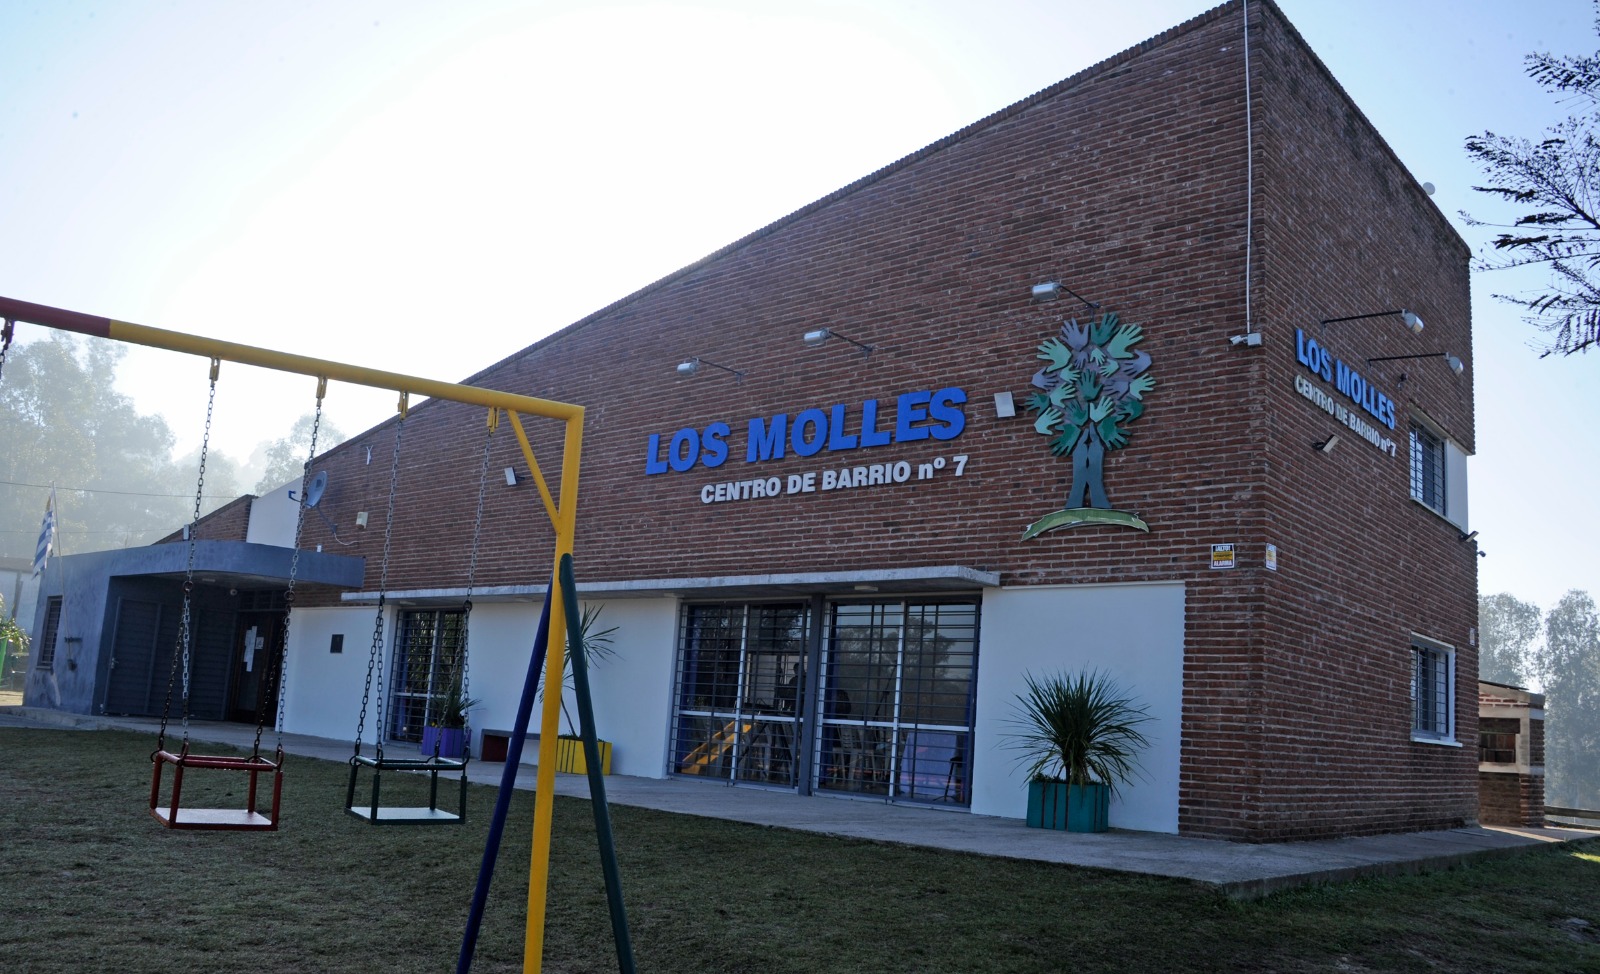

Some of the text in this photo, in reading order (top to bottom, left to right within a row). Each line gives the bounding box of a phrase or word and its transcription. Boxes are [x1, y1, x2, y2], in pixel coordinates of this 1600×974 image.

[1295, 375, 1334, 415] CENTRO
[1335, 402, 1348, 425] DE
[1349, 413, 1380, 447] BARRIO
[1390, 442, 1396, 457] 7
[1296, 328, 1396, 430] LOS MOLLES
[645, 386, 968, 475] LOS MOLLES
[700, 477, 782, 504] CENTRO
[786, 472, 817, 495] DE
[821, 460, 912, 491] BARRIO
[952, 455, 969, 477] 7
